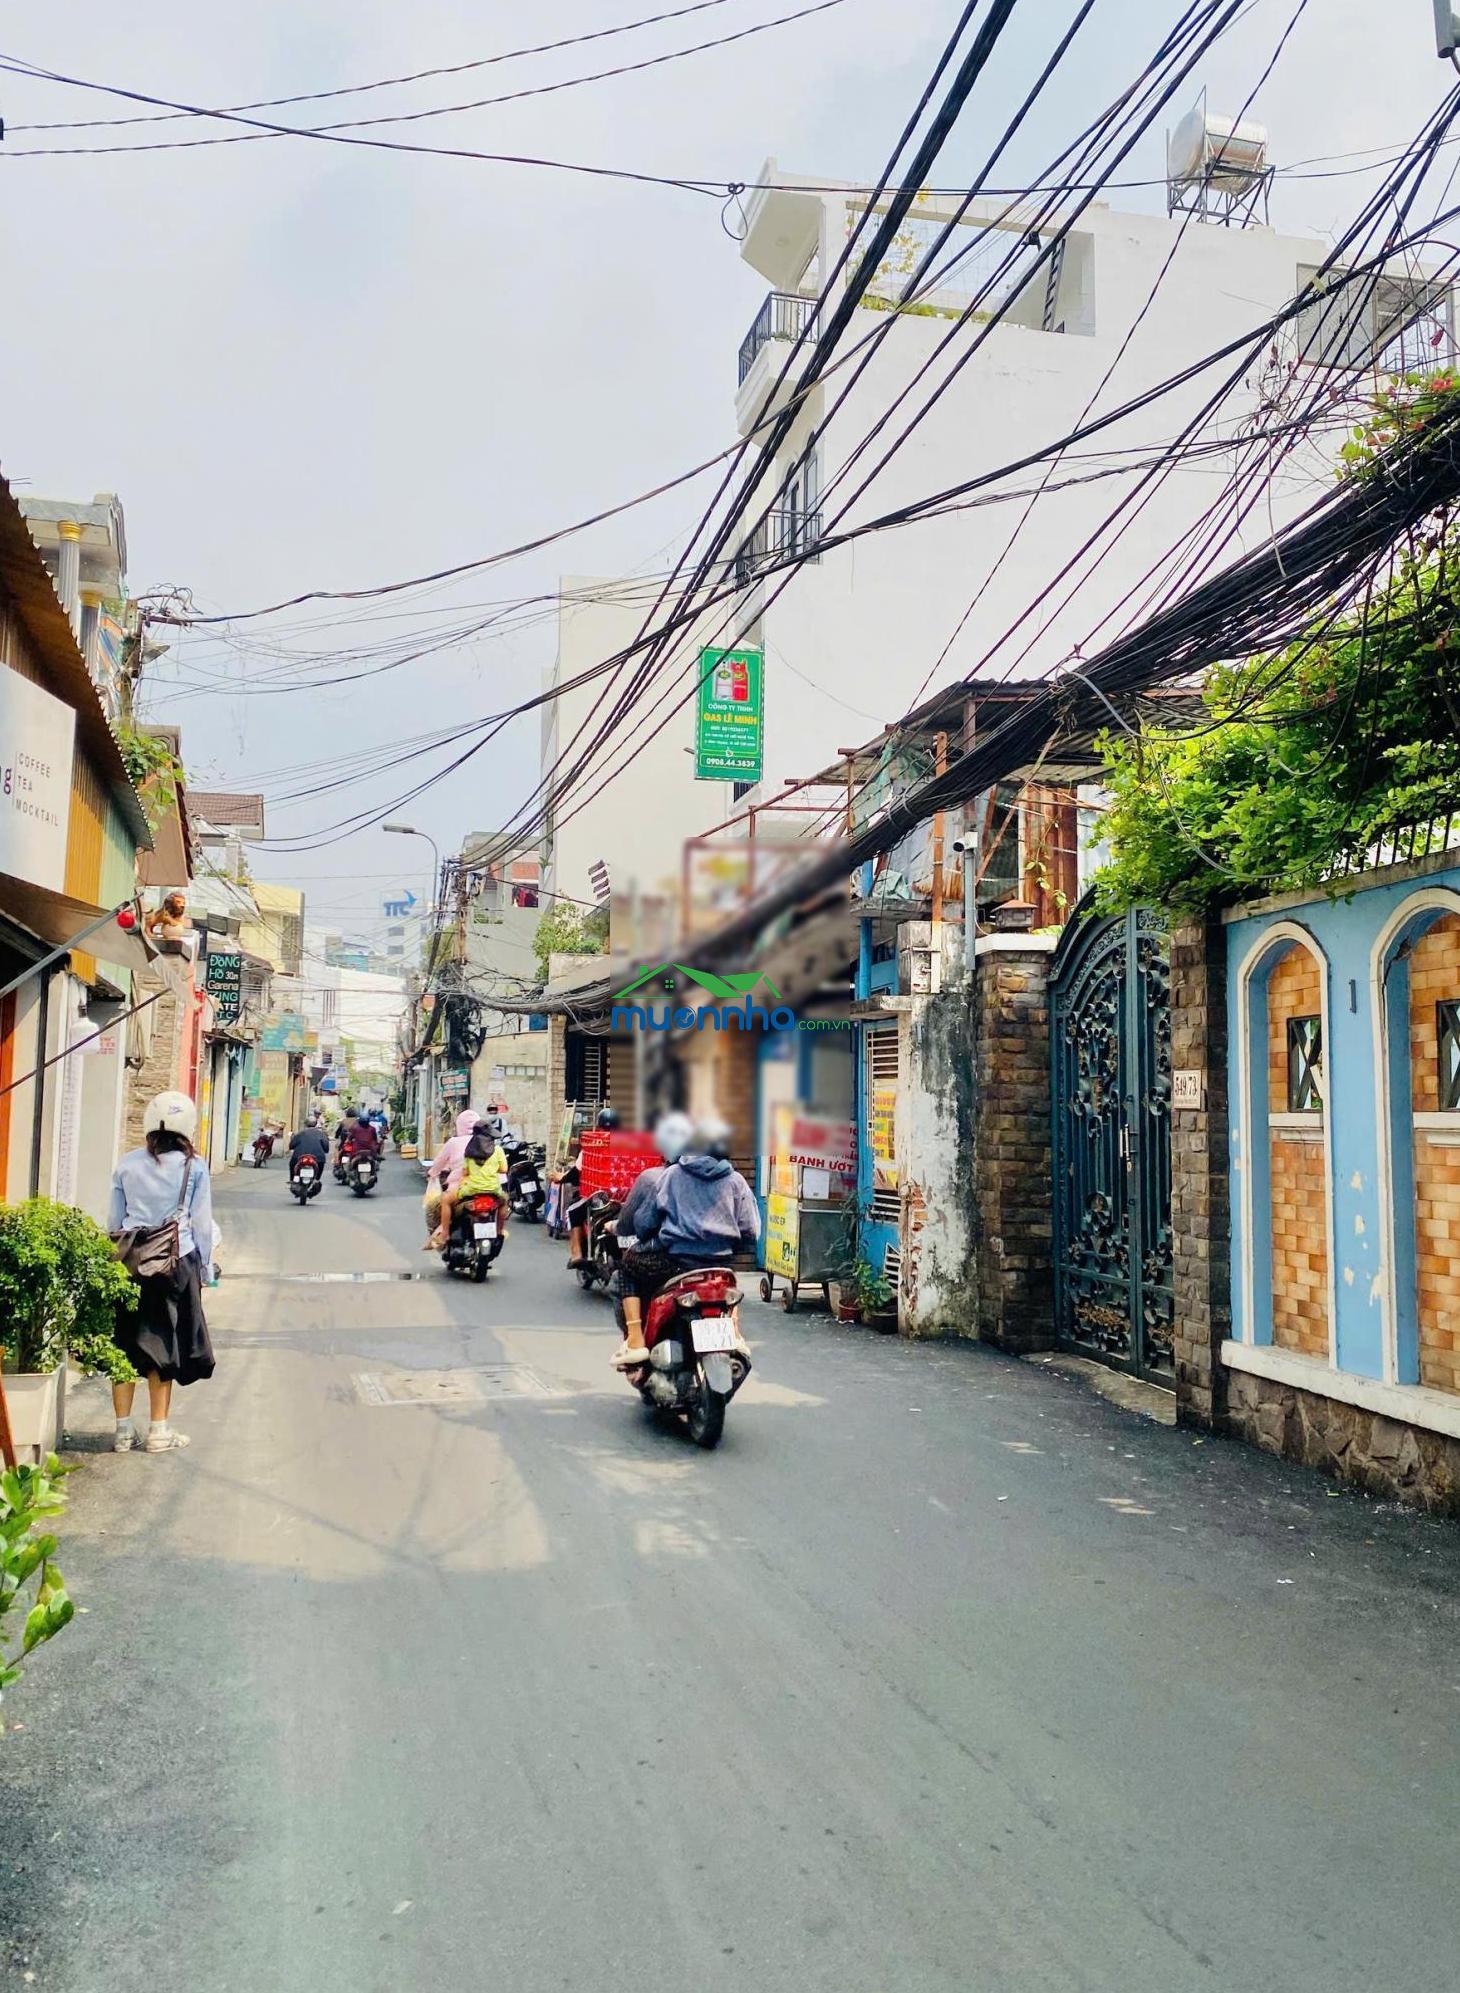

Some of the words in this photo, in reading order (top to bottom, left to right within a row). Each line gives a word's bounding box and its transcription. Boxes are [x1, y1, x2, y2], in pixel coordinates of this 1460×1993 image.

[19, 752, 51, 779] COFFEE
[17, 775, 33, 792] TEA
[15, 798, 59, 828] MOCKTAIL
[209, 954, 241, 968] ĐỒNG
[207, 980, 239, 991] Garena
